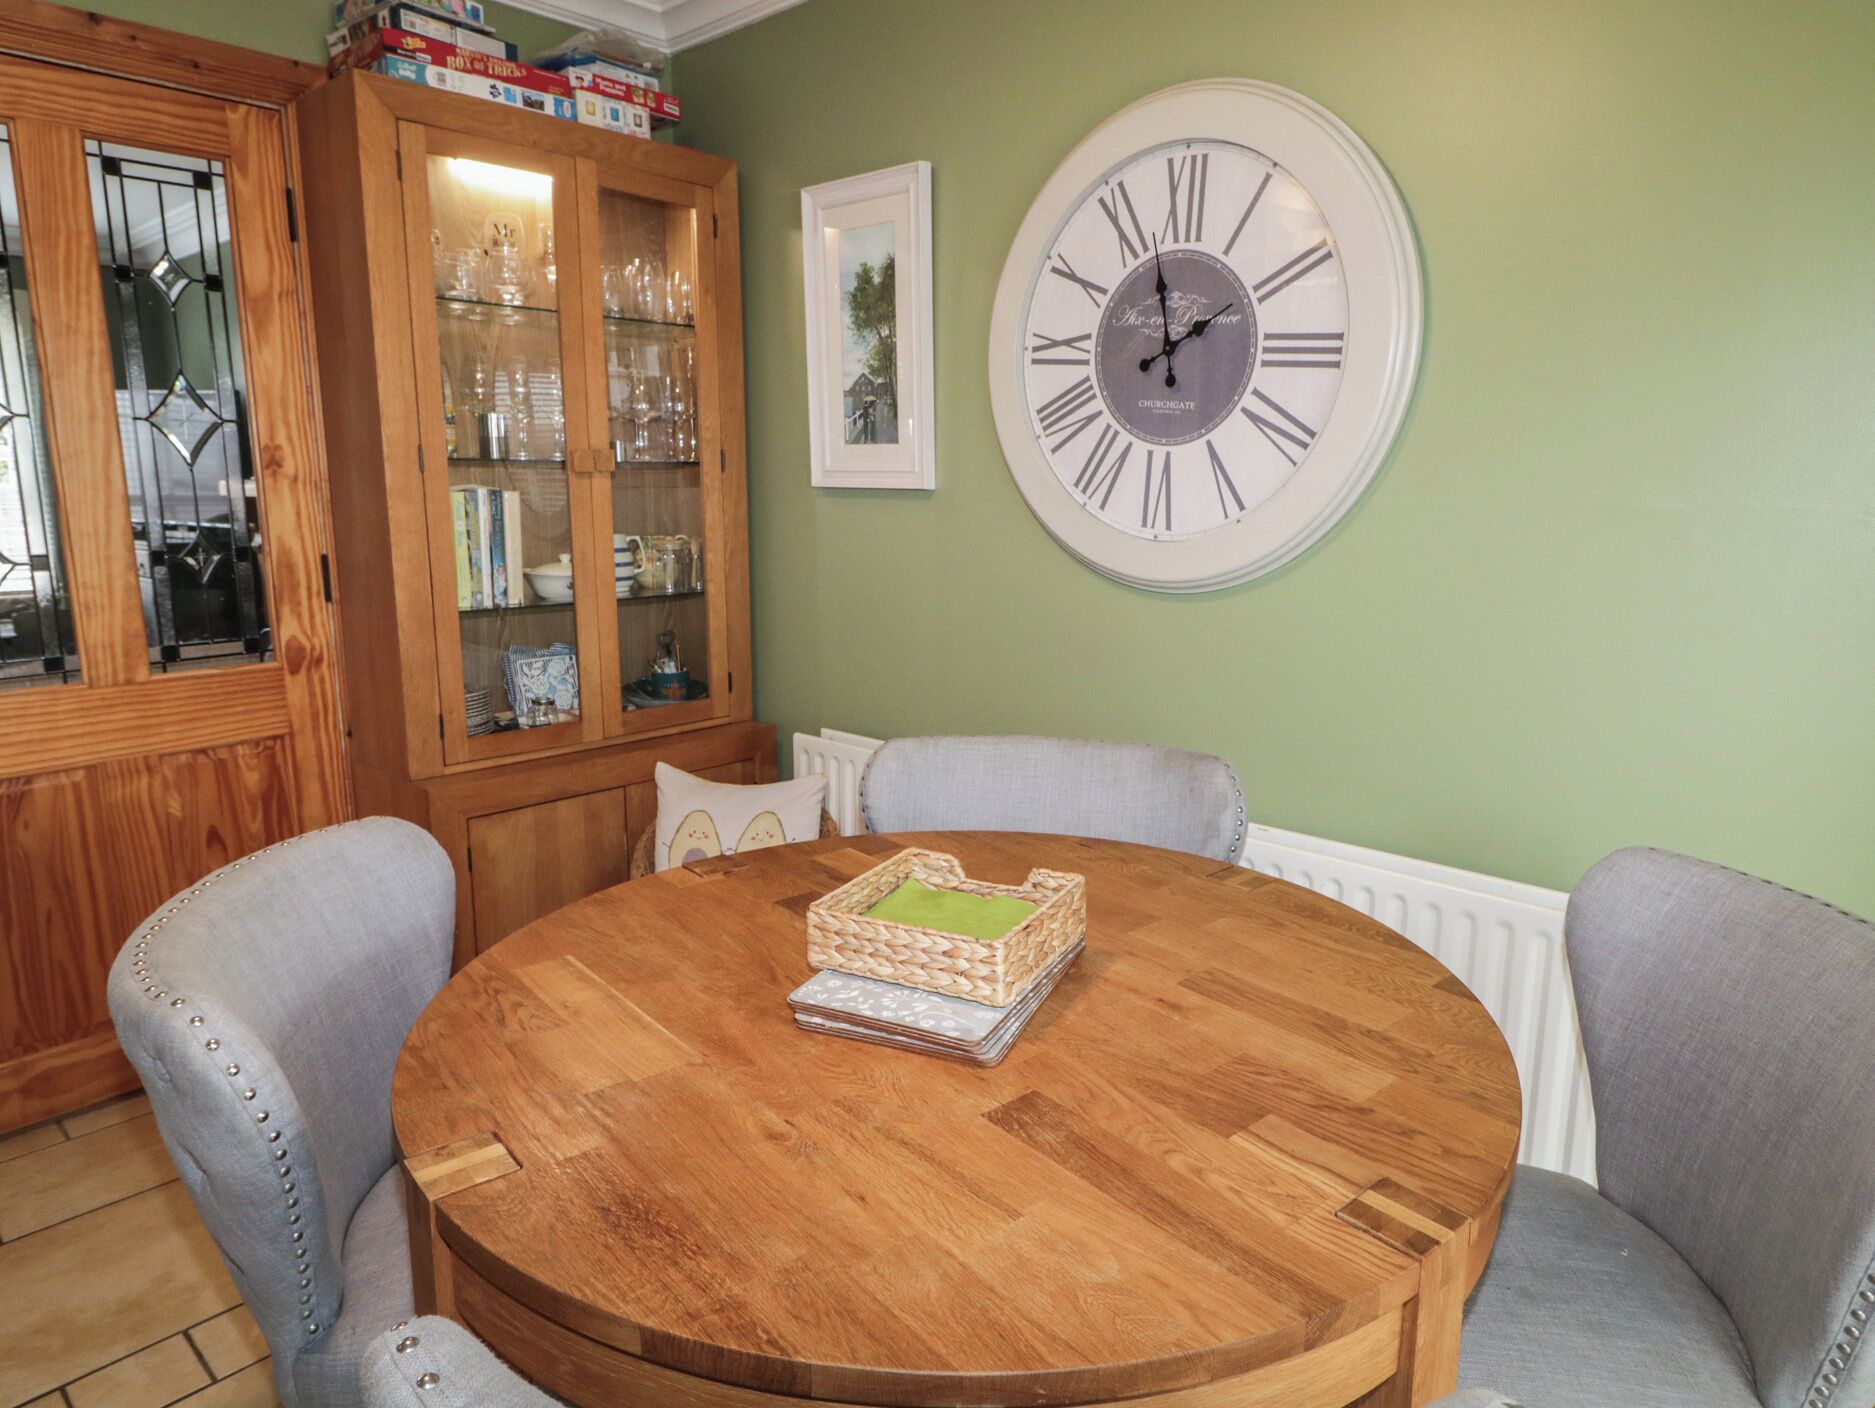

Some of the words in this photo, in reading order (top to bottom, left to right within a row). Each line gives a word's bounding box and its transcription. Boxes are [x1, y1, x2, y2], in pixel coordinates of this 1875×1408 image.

[446, 55, 472, 72] BOX
[485, 61, 527, 77] TRICKS
[493, 223, 516, 238] Mr
[1097, 180, 1150, 268] XI
[1160, 153, 1208, 244] XII
[1222, 172, 1273, 256] I
[1051, 253, 1109, 309] X
[1252, 237, 1333, 305] II
[1031, 333, 1092, 366] IX
[1112, 304, 1242, 326] Aix-en-Prence
[1261, 332, 1344, 369] III
[1036, 375, 1103, 455] VIII
[1138, 400, 1195, 410] CHURCHGATE
[1241, 387, 1317, 467] IV
[1074, 423, 1133, 511] VII
[1142, 450, 1171, 531] VI
[1206, 440, 1247, 520] V
